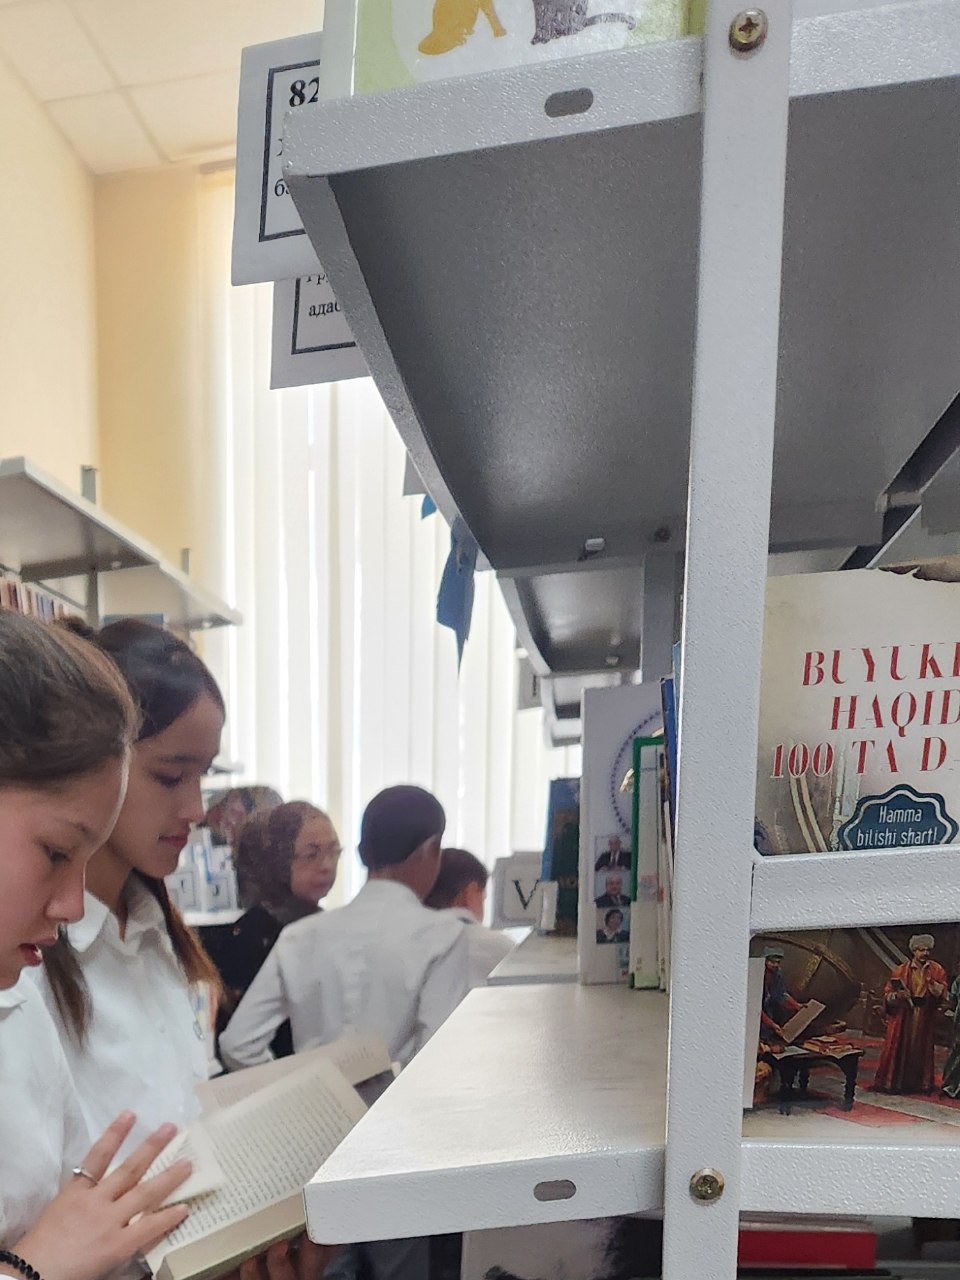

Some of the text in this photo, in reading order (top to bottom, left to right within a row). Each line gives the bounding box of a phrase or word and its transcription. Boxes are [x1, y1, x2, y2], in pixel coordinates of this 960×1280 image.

[828, 689, 960, 738] HAQID
[770, 742, 834, 779] 100
[852, 739, 899, 775] TA
[879, 805, 922, 825] Hamma
[857, 826, 938, 847] bilishi shart!
